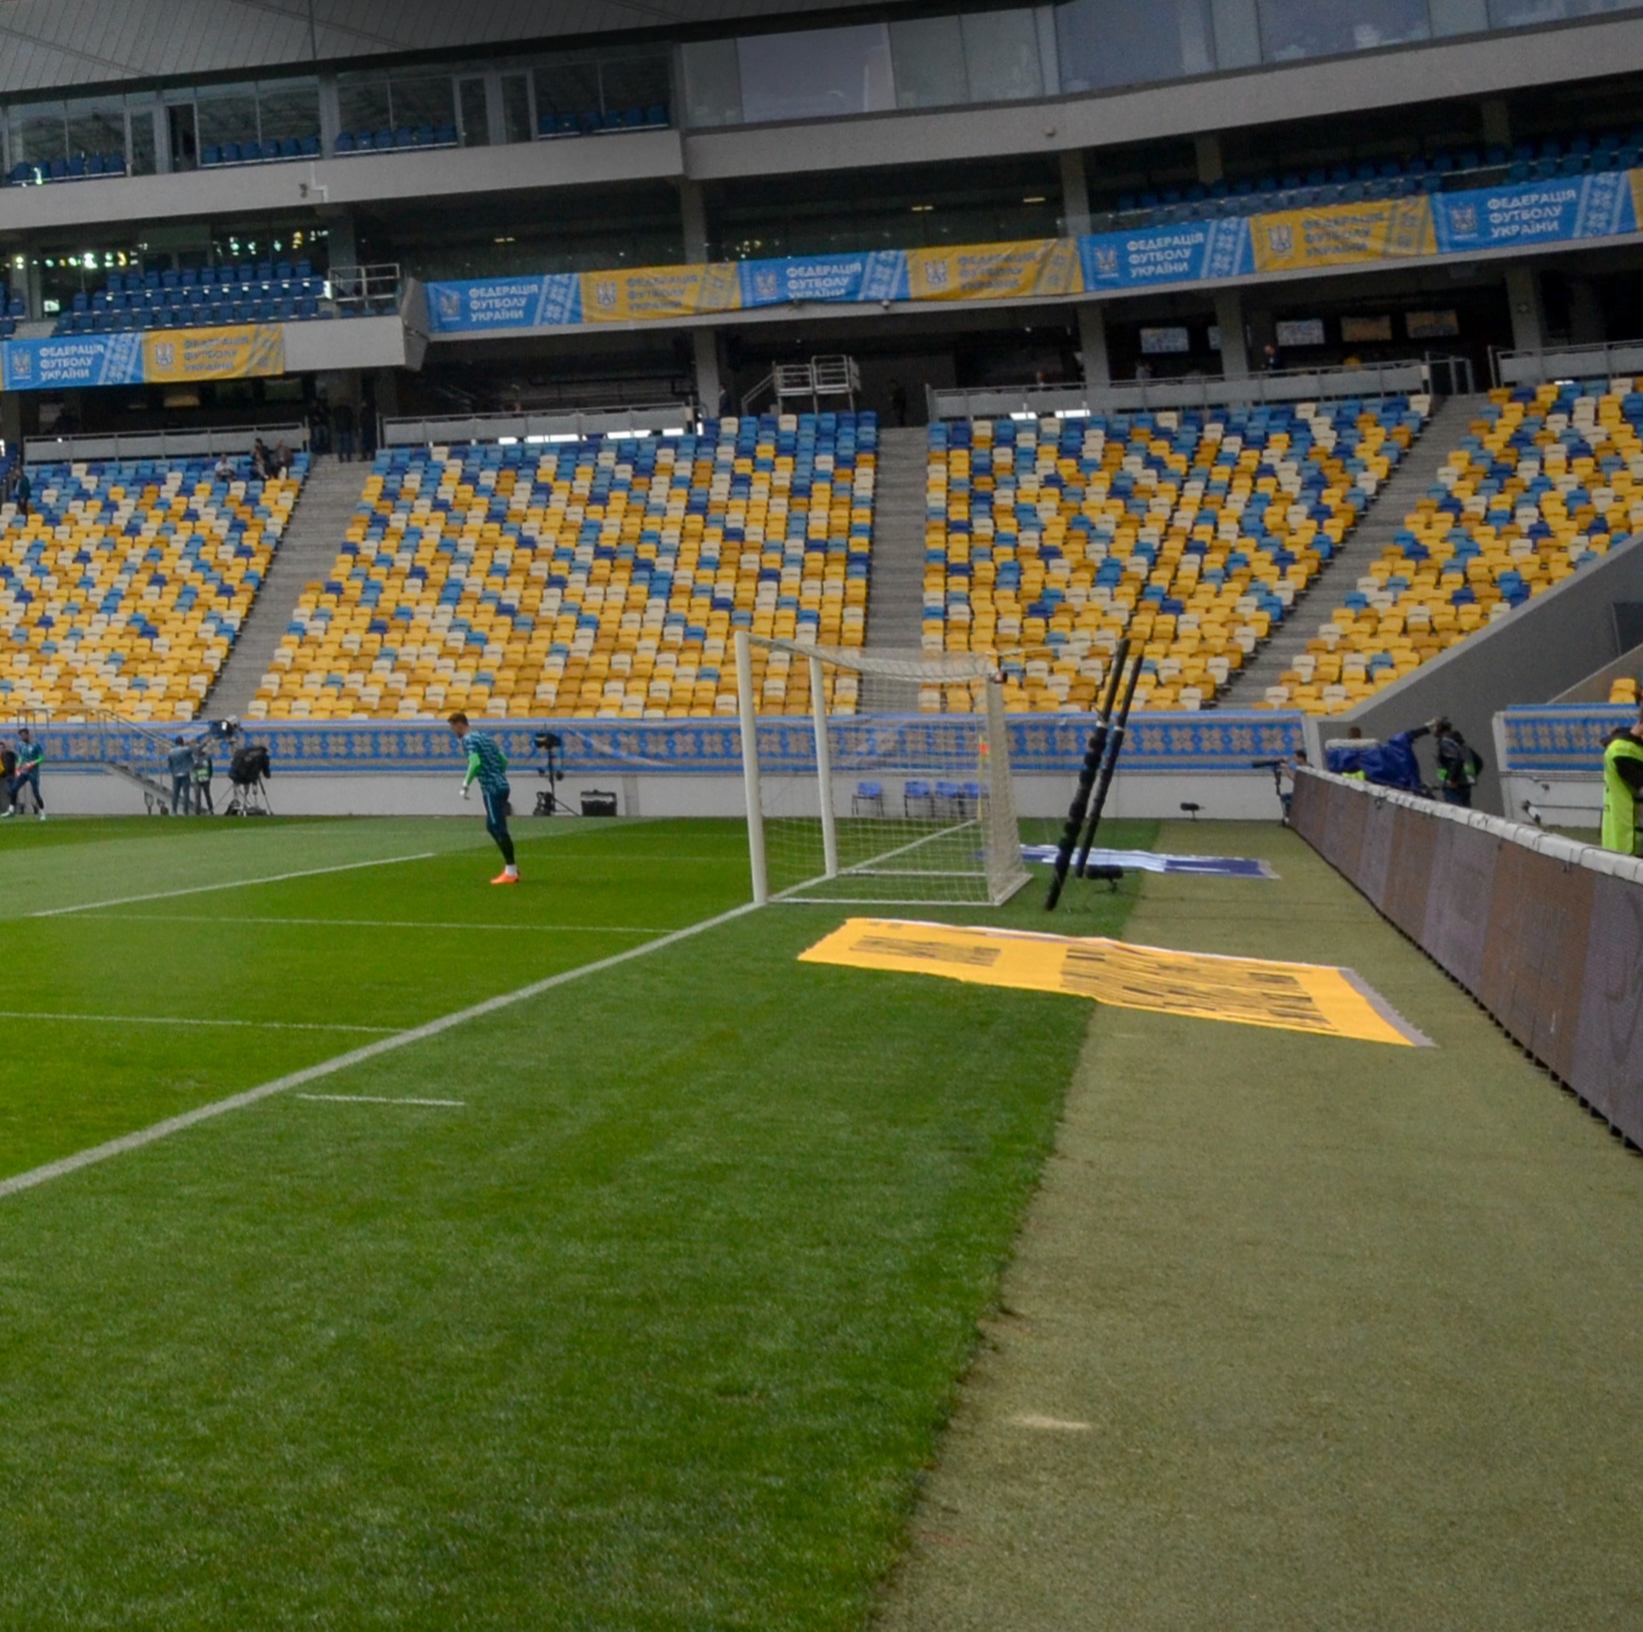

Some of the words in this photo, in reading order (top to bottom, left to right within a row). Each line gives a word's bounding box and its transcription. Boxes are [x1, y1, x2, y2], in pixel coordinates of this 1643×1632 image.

[1487, 189, 1577, 210] ФЕДЕРАЦІЯ
[1489, 205, 1563, 224] ФУТБОЛУ
[1491, 221, 1559, 238] УКРАЇНИ
[1127, 232, 1204, 252] ФЕДЕРАЦІЯ
[1128, 248, 1192, 265] ФУТБОЛУ
[786, 262, 861, 278] ФЕДЕРАЦІЯ
[1129, 261, 1189, 279] УКРАЇНИ
[468, 283, 538, 298] ФЕДЕРАЦІЯ
[787, 276, 849, 290] ФУТБОЛУ
[788, 287, 846, 300] УКРАЇНИ
[469, 297, 527, 310] ФУТБОЛУ
[471, 309, 524, 323] УКРАЇНИ
[39, 343, 105, 358] ФЕДЕРАЦІЯ
[40, 357, 93, 369] ФУТБОЛУ
[40, 368, 90, 381] УКРАЇНИ
